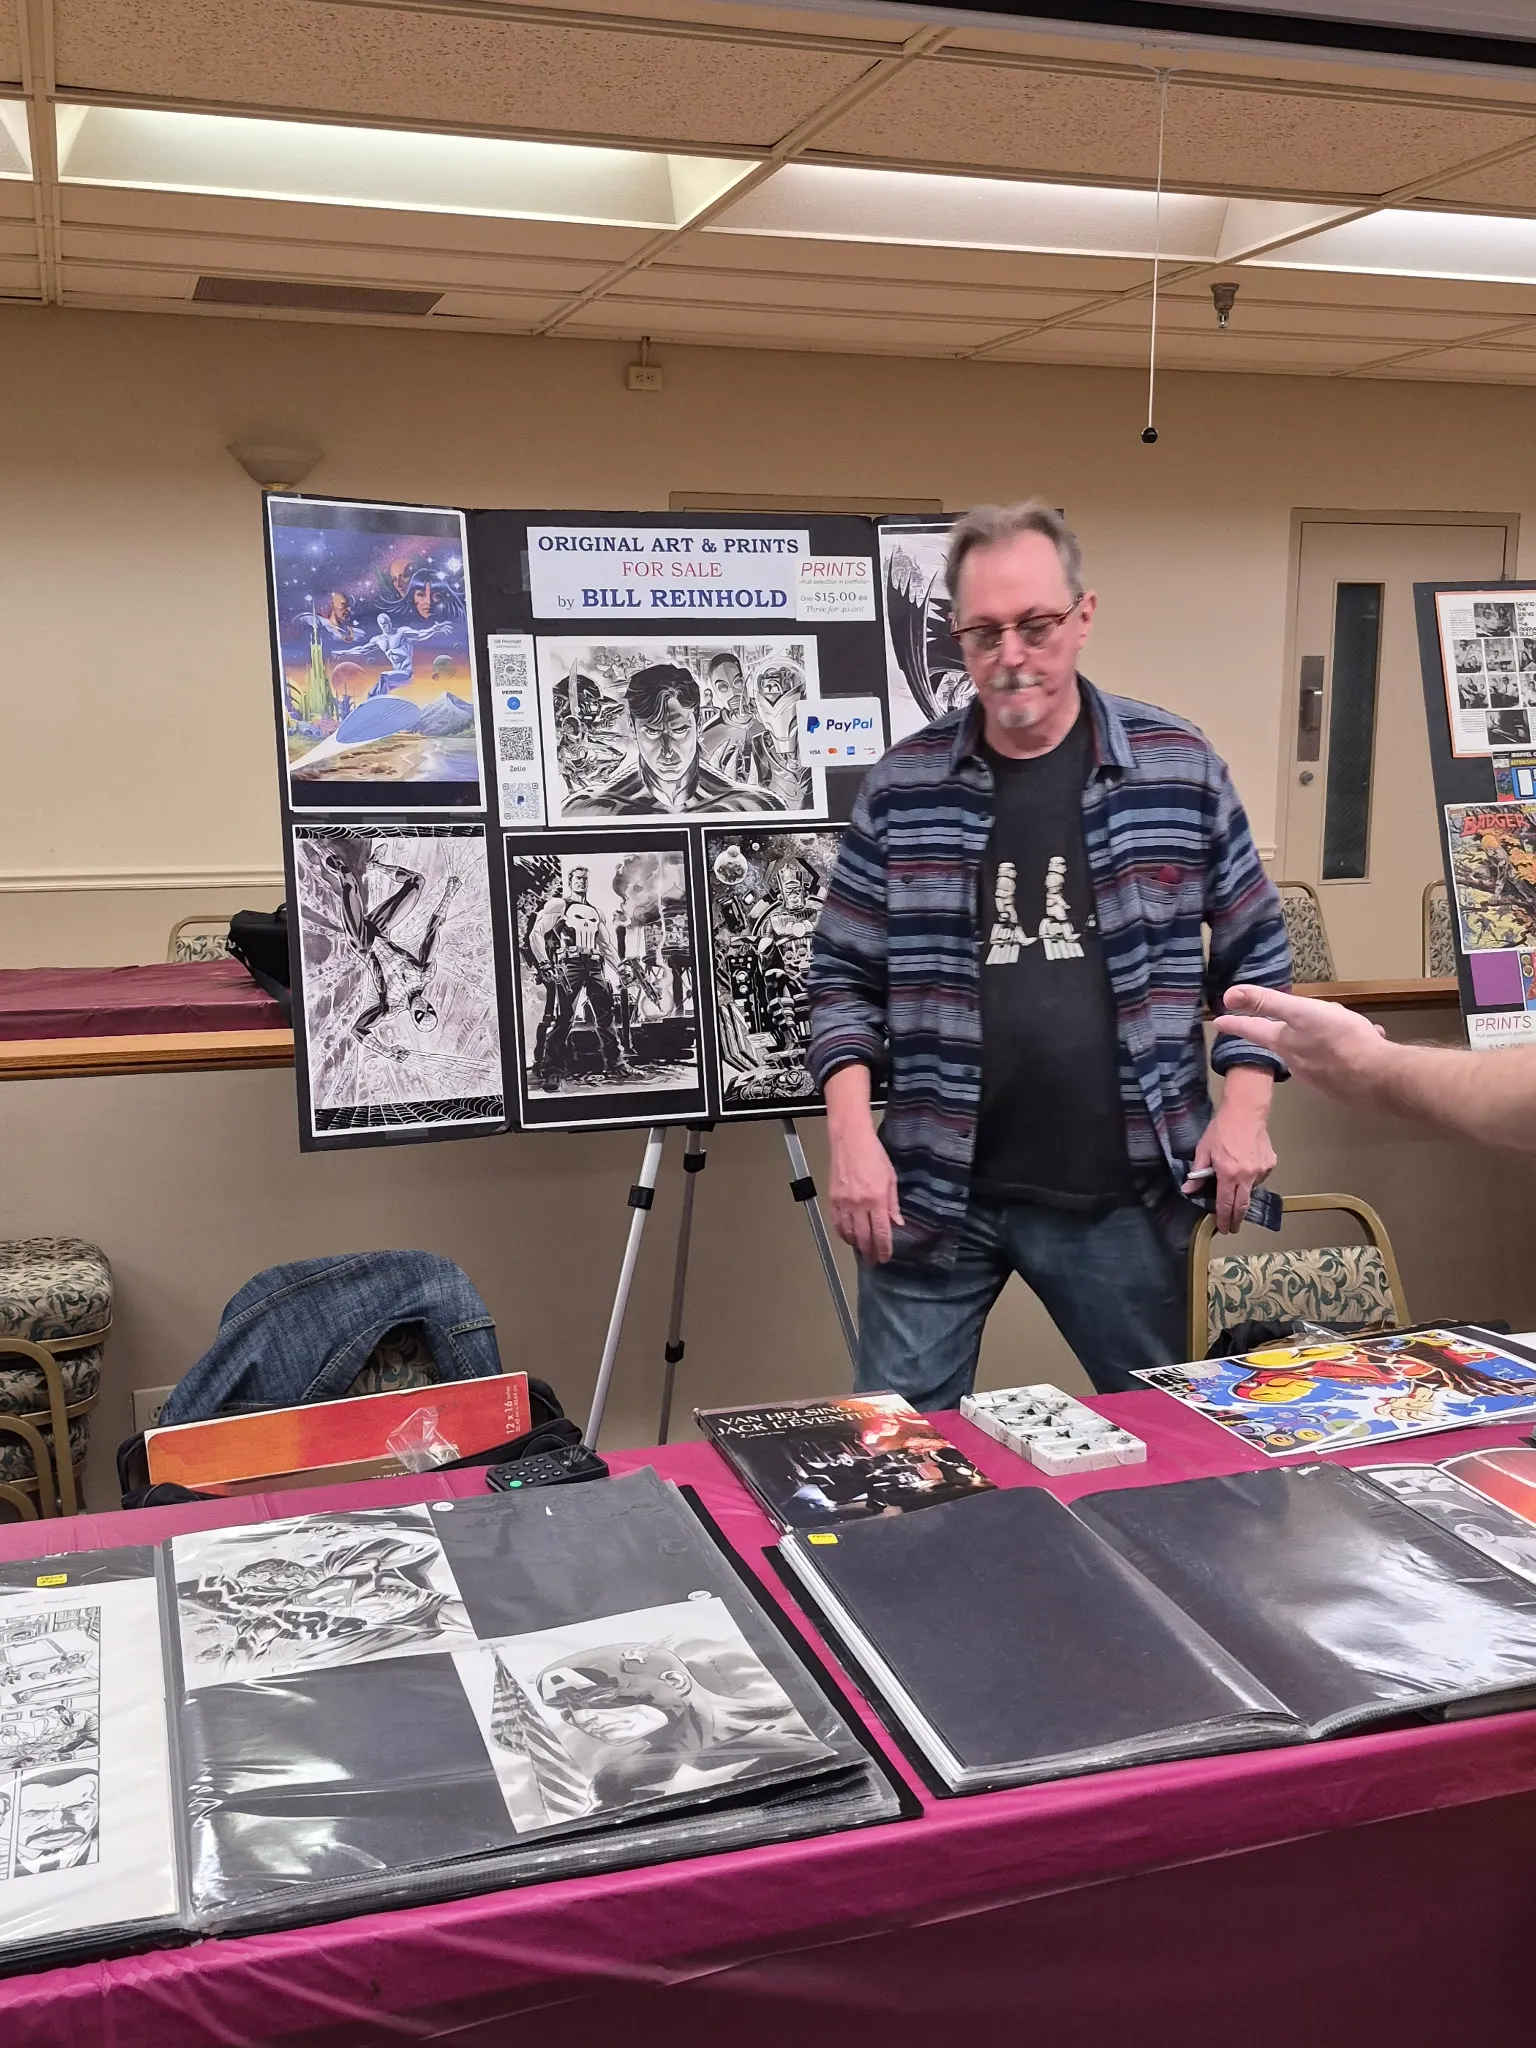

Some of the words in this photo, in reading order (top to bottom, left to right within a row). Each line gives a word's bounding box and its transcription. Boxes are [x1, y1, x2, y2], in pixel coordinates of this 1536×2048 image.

[538, 536, 645, 552] ORIGINAL
[651, 537, 694, 552] ART
[702, 538, 717, 553] &
[724, 538, 799, 554] PRINTS
[622, 562, 664, 577] FOR
[671, 562, 723, 578] SALE
[801, 562, 866, 577] PRINTS
[558, 595, 575, 611] by
[581, 588, 642, 608] BILL
[650, 589, 788, 608] REINHOLD
[814, 592, 856, 604] $15.00
[827, 606, 838, 614] for
[826, 718, 873, 732] PayPal
[1460, 813, 1531, 837] BADGER
[1475, 1015, 1532, 1032] PRINTS
[504, 1400, 513, 1412] 16
[718, 1414, 762, 1426] VAN
[765, 1404, 852, 1421] HELSING
[506, 1422, 515, 1434] 12
[718, 1422, 768, 1436] JACK
